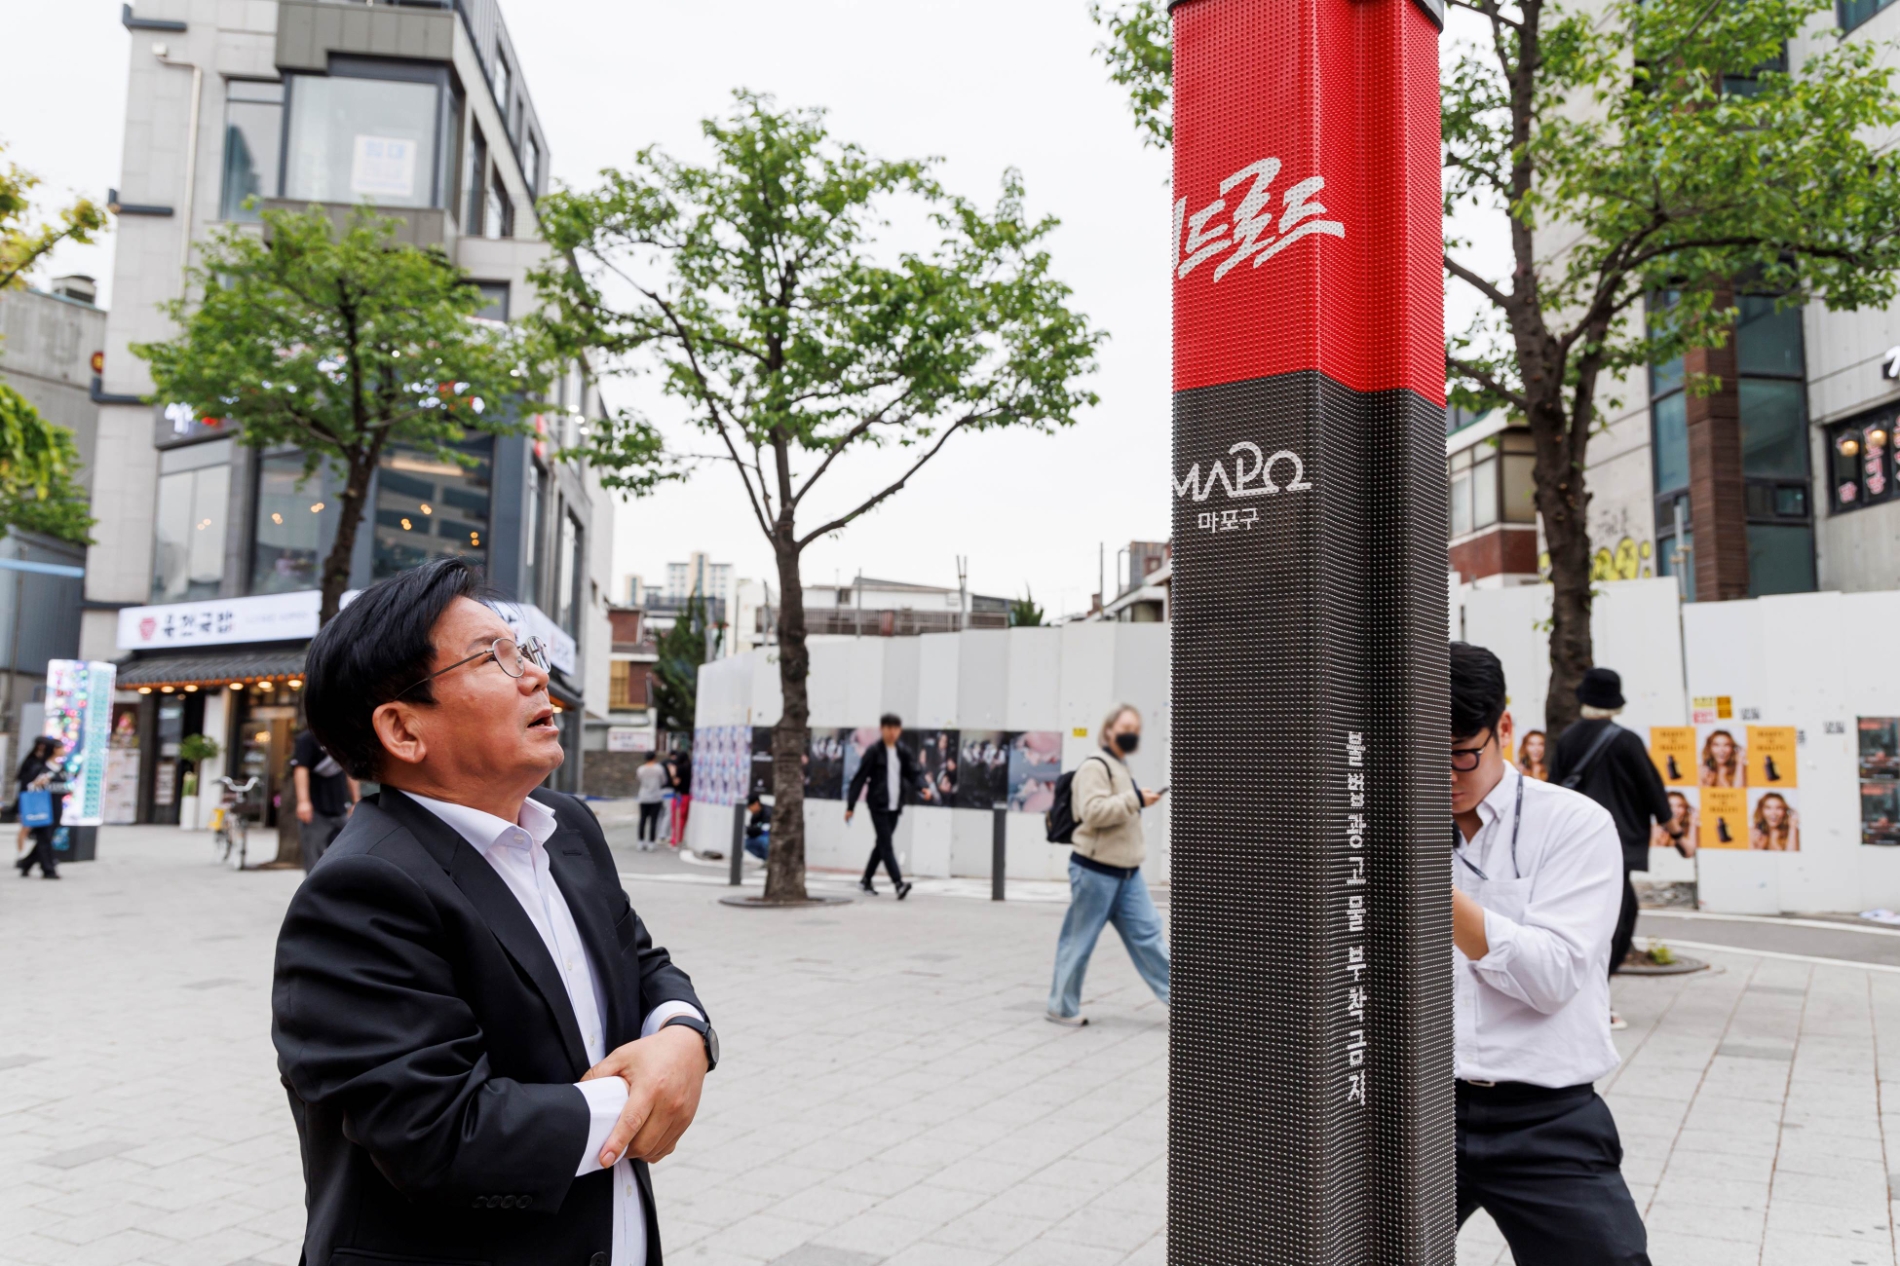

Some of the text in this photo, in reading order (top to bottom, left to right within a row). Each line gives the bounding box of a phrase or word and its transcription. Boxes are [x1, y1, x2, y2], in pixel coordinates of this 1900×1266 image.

[1174, 156, 1346, 284] 드로드
[1198, 507, 1260, 534] 마포구
[1346, 731, 1368, 1106] 불법광고물 부착금지
